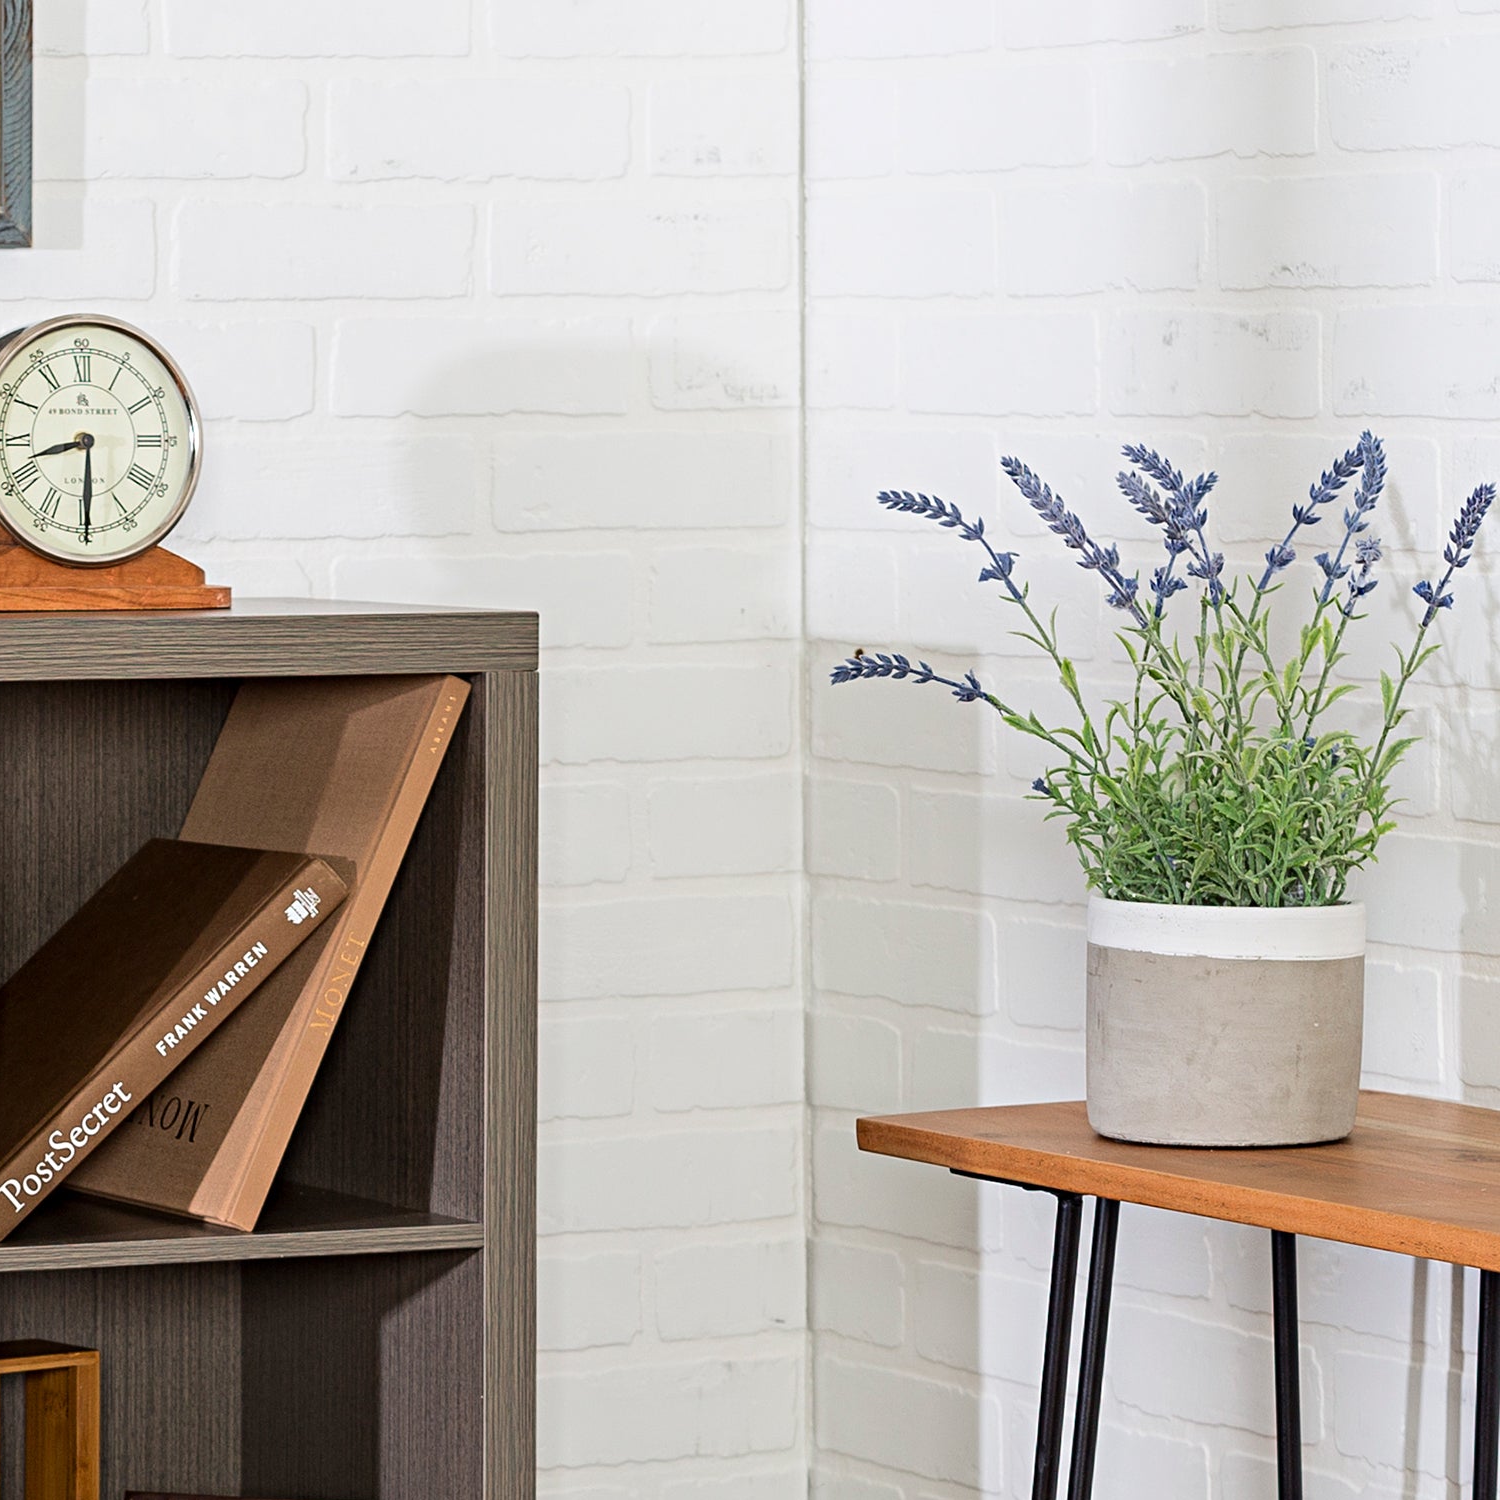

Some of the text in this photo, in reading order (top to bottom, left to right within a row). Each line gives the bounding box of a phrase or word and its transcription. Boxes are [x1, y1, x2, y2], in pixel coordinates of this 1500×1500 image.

[73, 338, 90, 348] 60
[28, 348, 44, 362] 55
[122, 352, 132, 361] 5
[73, 355, 92, 383] XII
[38, 364, 61, 393] XI
[155, 386, 165, 399] 10
[128, 395, 153, 415] II
[137, 434, 162, 448] III
[168, 435, 178, 447] 15
[0, 481, 13, 497] 40
[156, 482, 169, 498] 20
[33, 518, 49, 532] 35
[122, 519, 138, 533] 25
[310, 931, 365, 1036] MONET
[155, 1002, 208, 1057] FRANK
[203, 941, 268, 1006] WARREN
